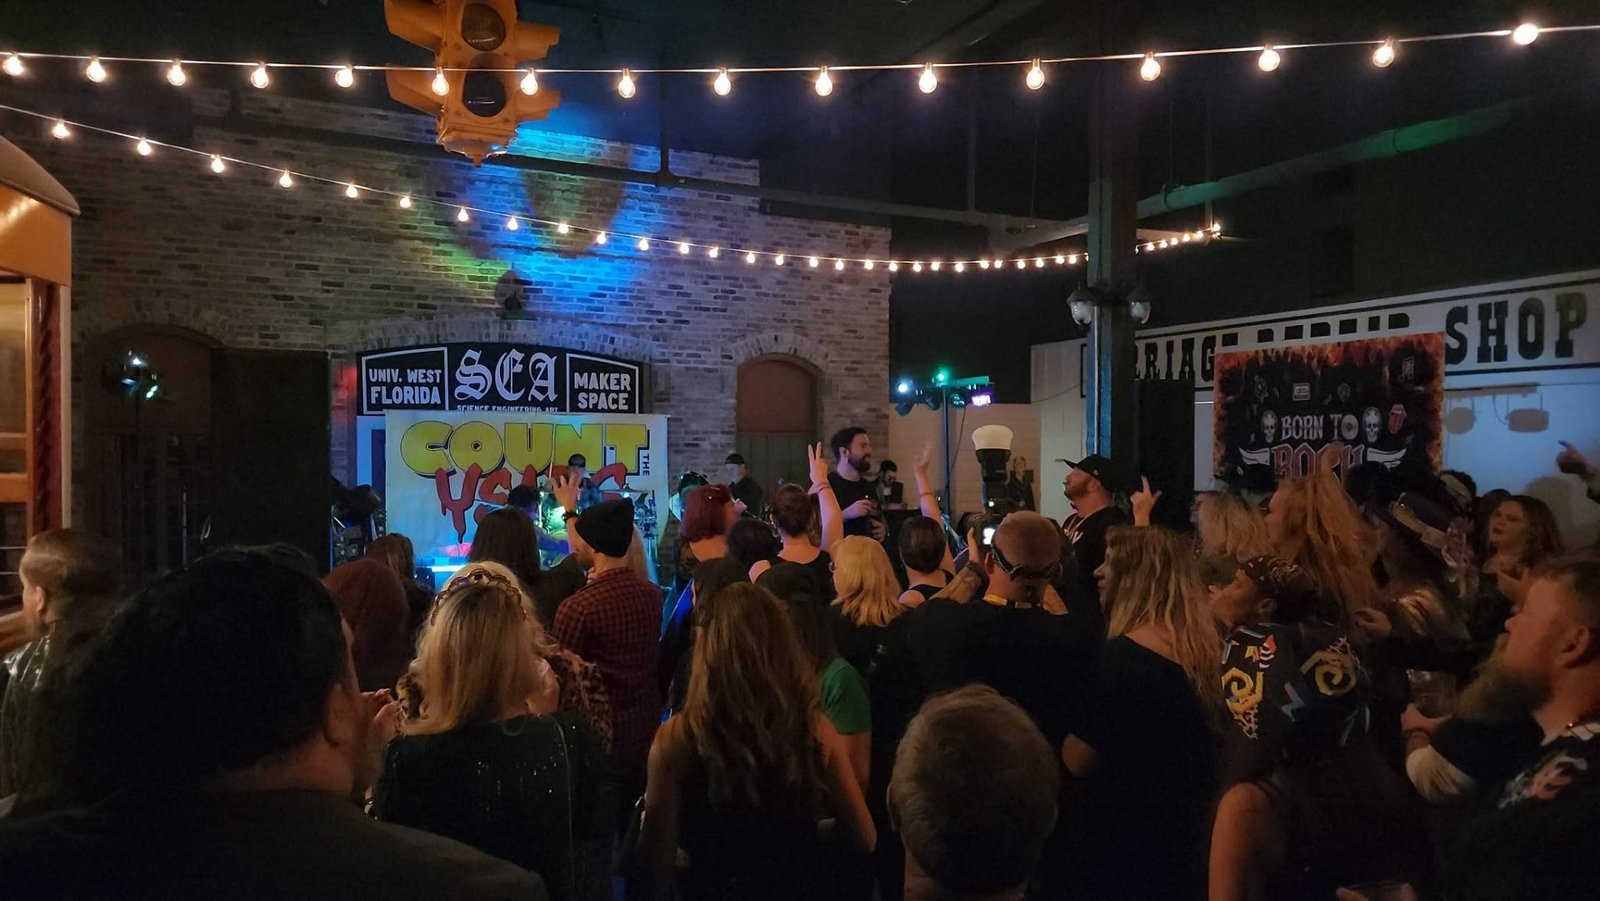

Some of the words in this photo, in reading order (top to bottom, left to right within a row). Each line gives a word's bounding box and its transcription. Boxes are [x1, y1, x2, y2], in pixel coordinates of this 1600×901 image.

[1134, 334, 1238, 382] RIAG
[1445, 292, 1587, 365] SHOP
[368, 368, 402, 383] UNIV.
[406, 368, 442, 383] WEST
[454, 348, 559, 401] SEA
[574, 372, 631, 391] MAKER
[370, 385, 442, 404] FLORIDA
[577, 392, 629, 410] SPACE
[1280, 414, 1324, 440] BORN
[1329, 413, 1359, 440] TO
[400, 420, 650, 478] COUNT
[642, 453, 650, 477] THE
